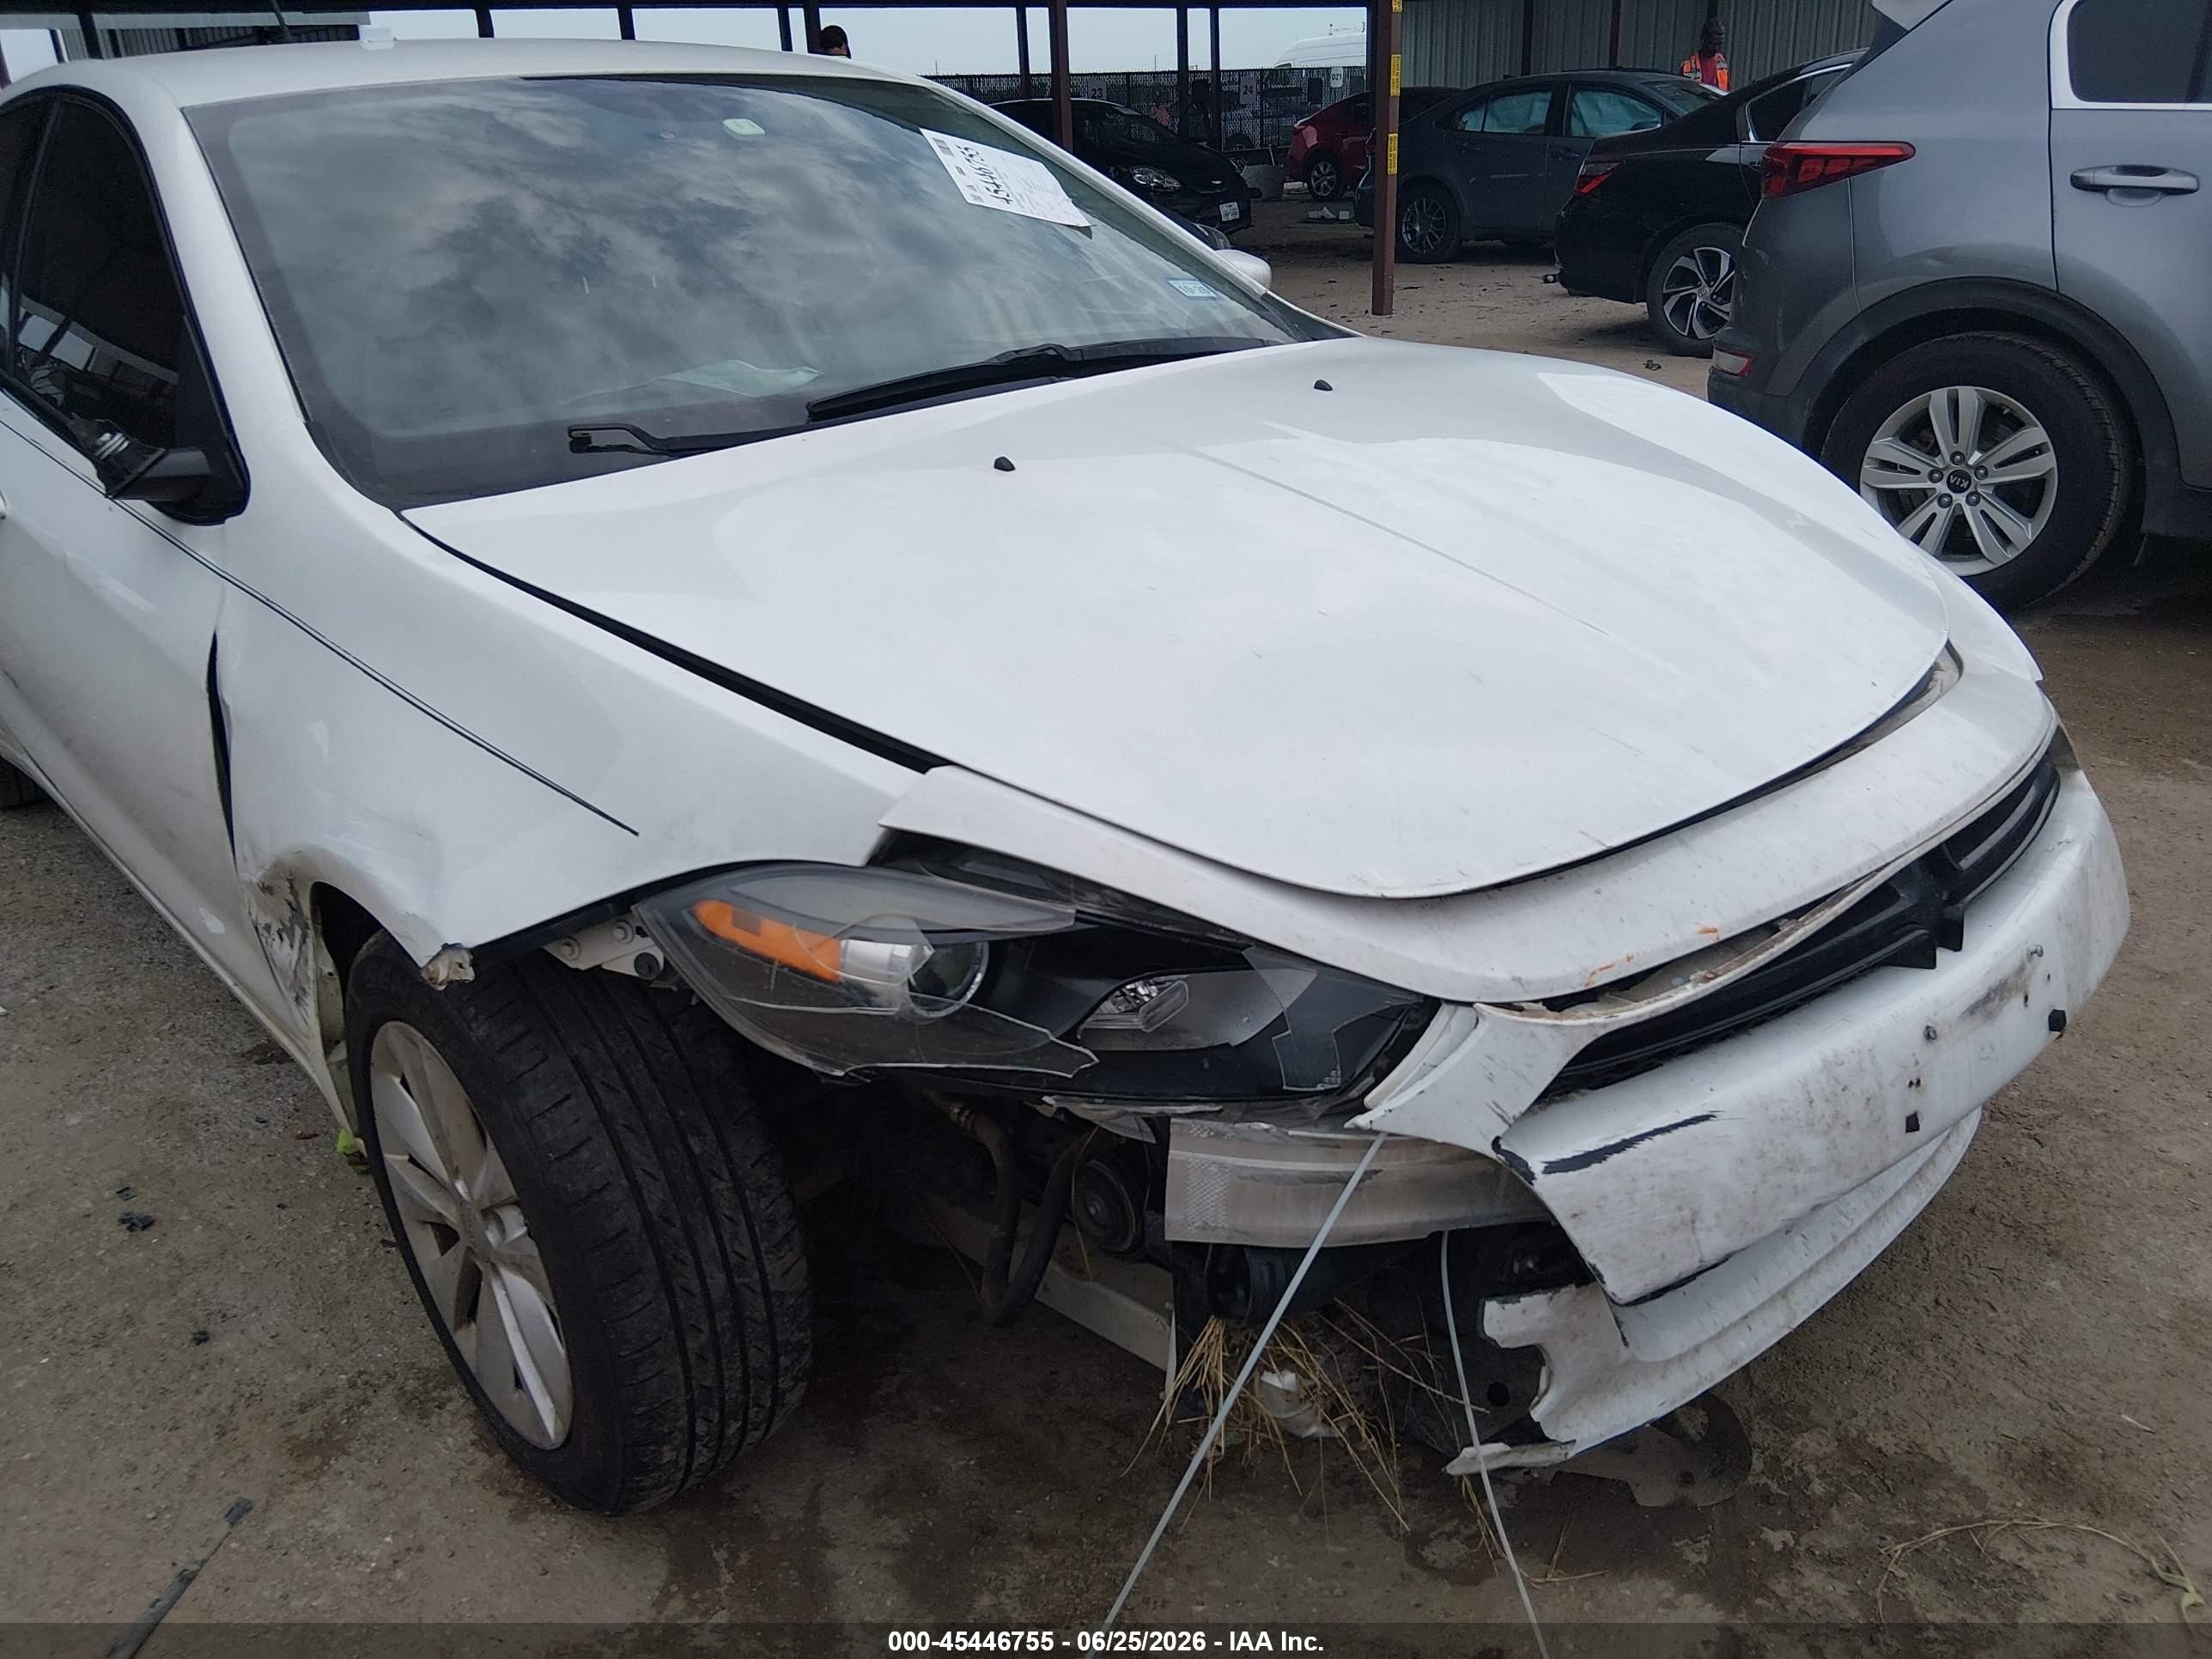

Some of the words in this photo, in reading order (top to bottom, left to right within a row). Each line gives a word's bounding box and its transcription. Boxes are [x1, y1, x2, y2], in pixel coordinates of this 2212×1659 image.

[1091, 88, 1103, 98] 23
[1243, 85, 1254, 94] 24
[955, 143, 1013, 204] 45446755
[1949, 474, 1969, 489] KIA
